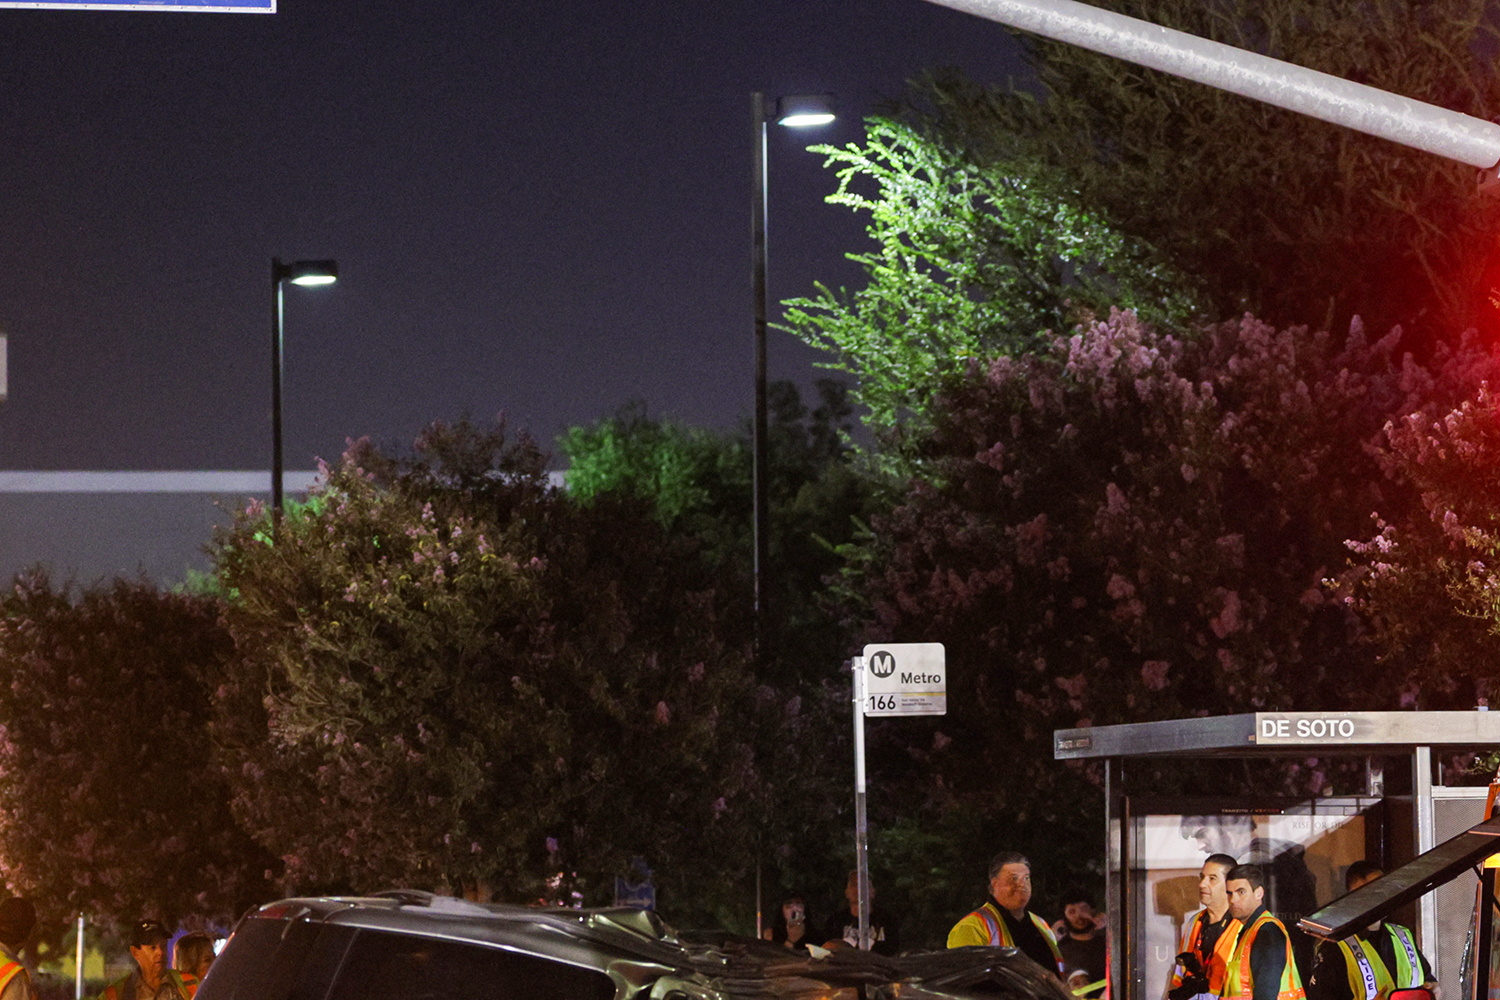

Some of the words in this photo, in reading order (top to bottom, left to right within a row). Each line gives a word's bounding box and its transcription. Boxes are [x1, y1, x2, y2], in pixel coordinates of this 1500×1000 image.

[901, 672, 942, 684] Metro
[869, 695, 897, 710] 166
[1262, 720, 1290, 737] DE
[1296, 719, 1355, 738] SOTO
[1351, 944, 1374, 991] POLICE
